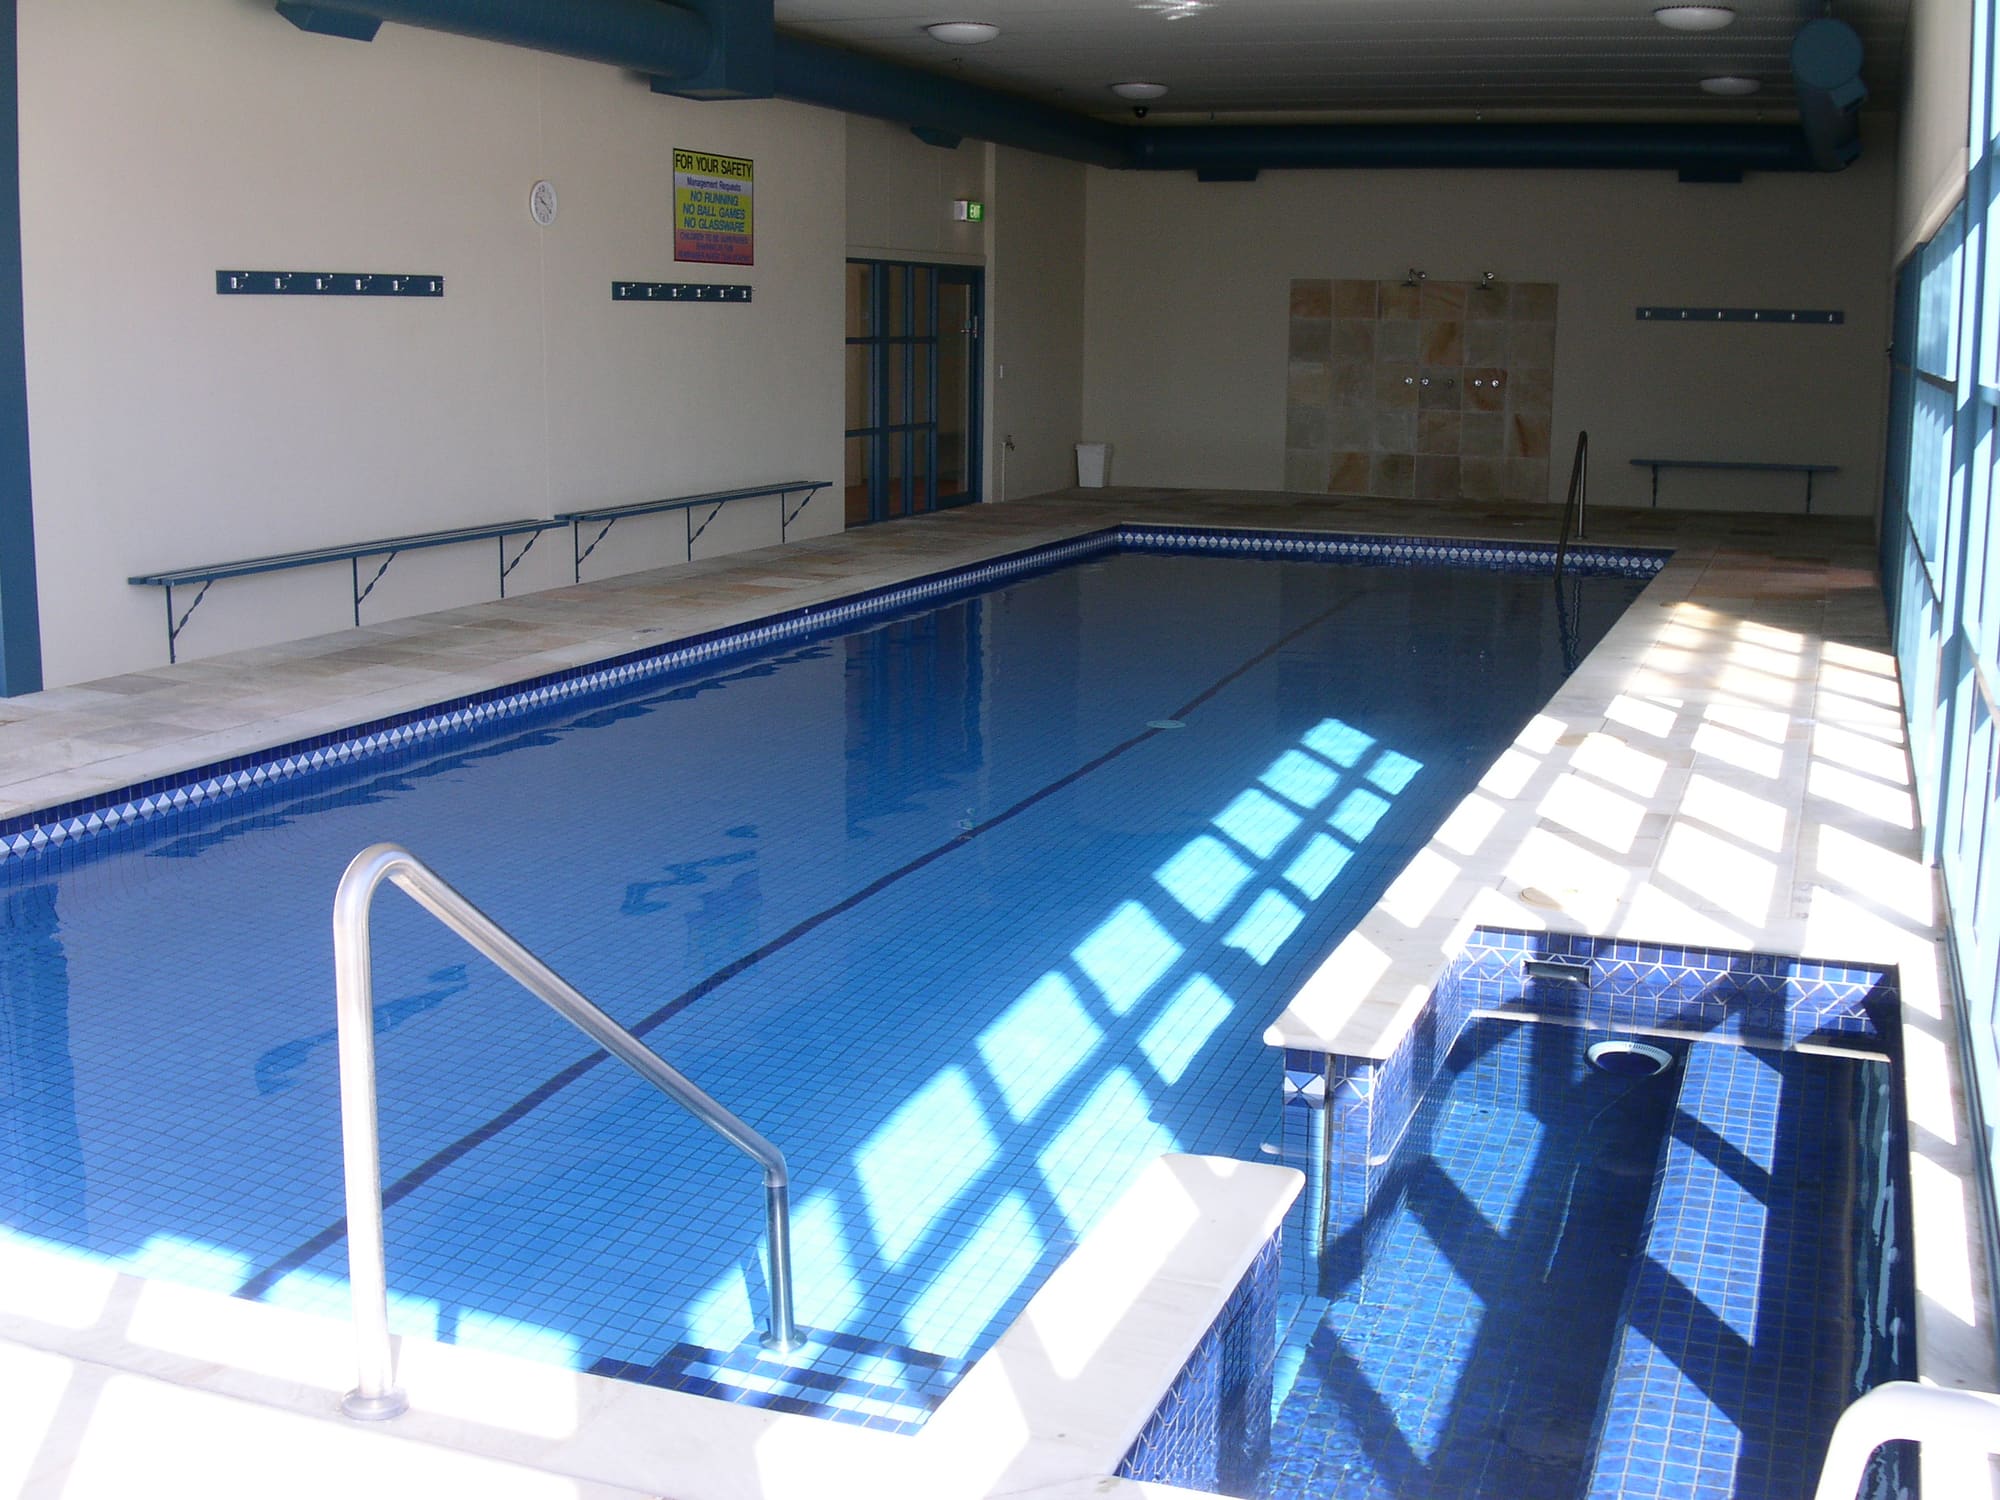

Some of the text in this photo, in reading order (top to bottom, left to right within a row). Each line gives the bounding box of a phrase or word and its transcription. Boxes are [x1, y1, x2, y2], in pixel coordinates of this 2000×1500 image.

[675, 153, 752, 177] FOR YOUR SAFETY
[687, 176, 741, 192] Management Requests
[690, 190, 739, 206] NO RUNNING
[683, 203, 745, 220] NO BALL GAMES
[684, 217, 745, 233] NO GLASSWARE
